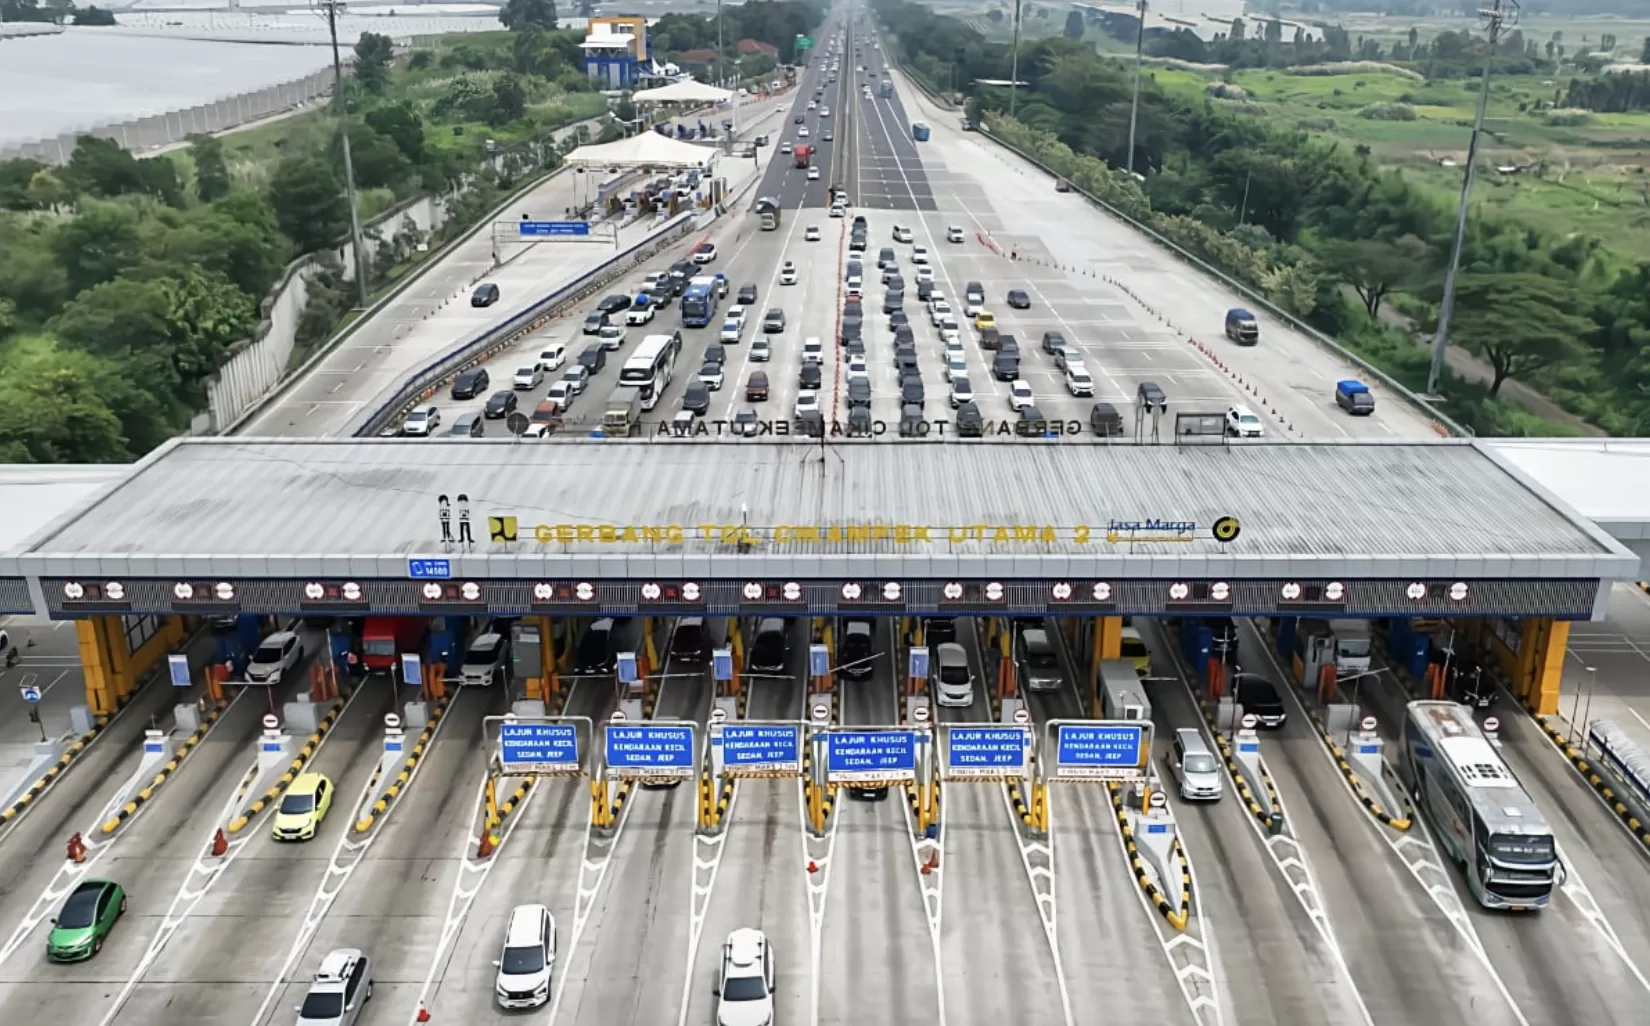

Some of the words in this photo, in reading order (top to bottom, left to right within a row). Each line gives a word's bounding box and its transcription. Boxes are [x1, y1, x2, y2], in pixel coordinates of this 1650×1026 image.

[1107, 519, 1140, 534] Jasa
[1146, 519, 1196, 534] Marga
[535, 524, 684, 544] GERBANG
[699, 524, 760, 545] TOL
[949, 524, 1057, 544] UTAMA
[1074, 524, 1091, 544] 2
[613, 731, 643, 739] LAJUR
[648, 731, 686, 739] KHUSUS
[951, 732, 982, 740] LAJUR
[985, 732, 1021, 740] KHUSUS
[1064, 732, 1095, 740] LAJUR
[834, 735, 866, 744] LAJUR
[870, 735, 908, 743] KHUSUS
